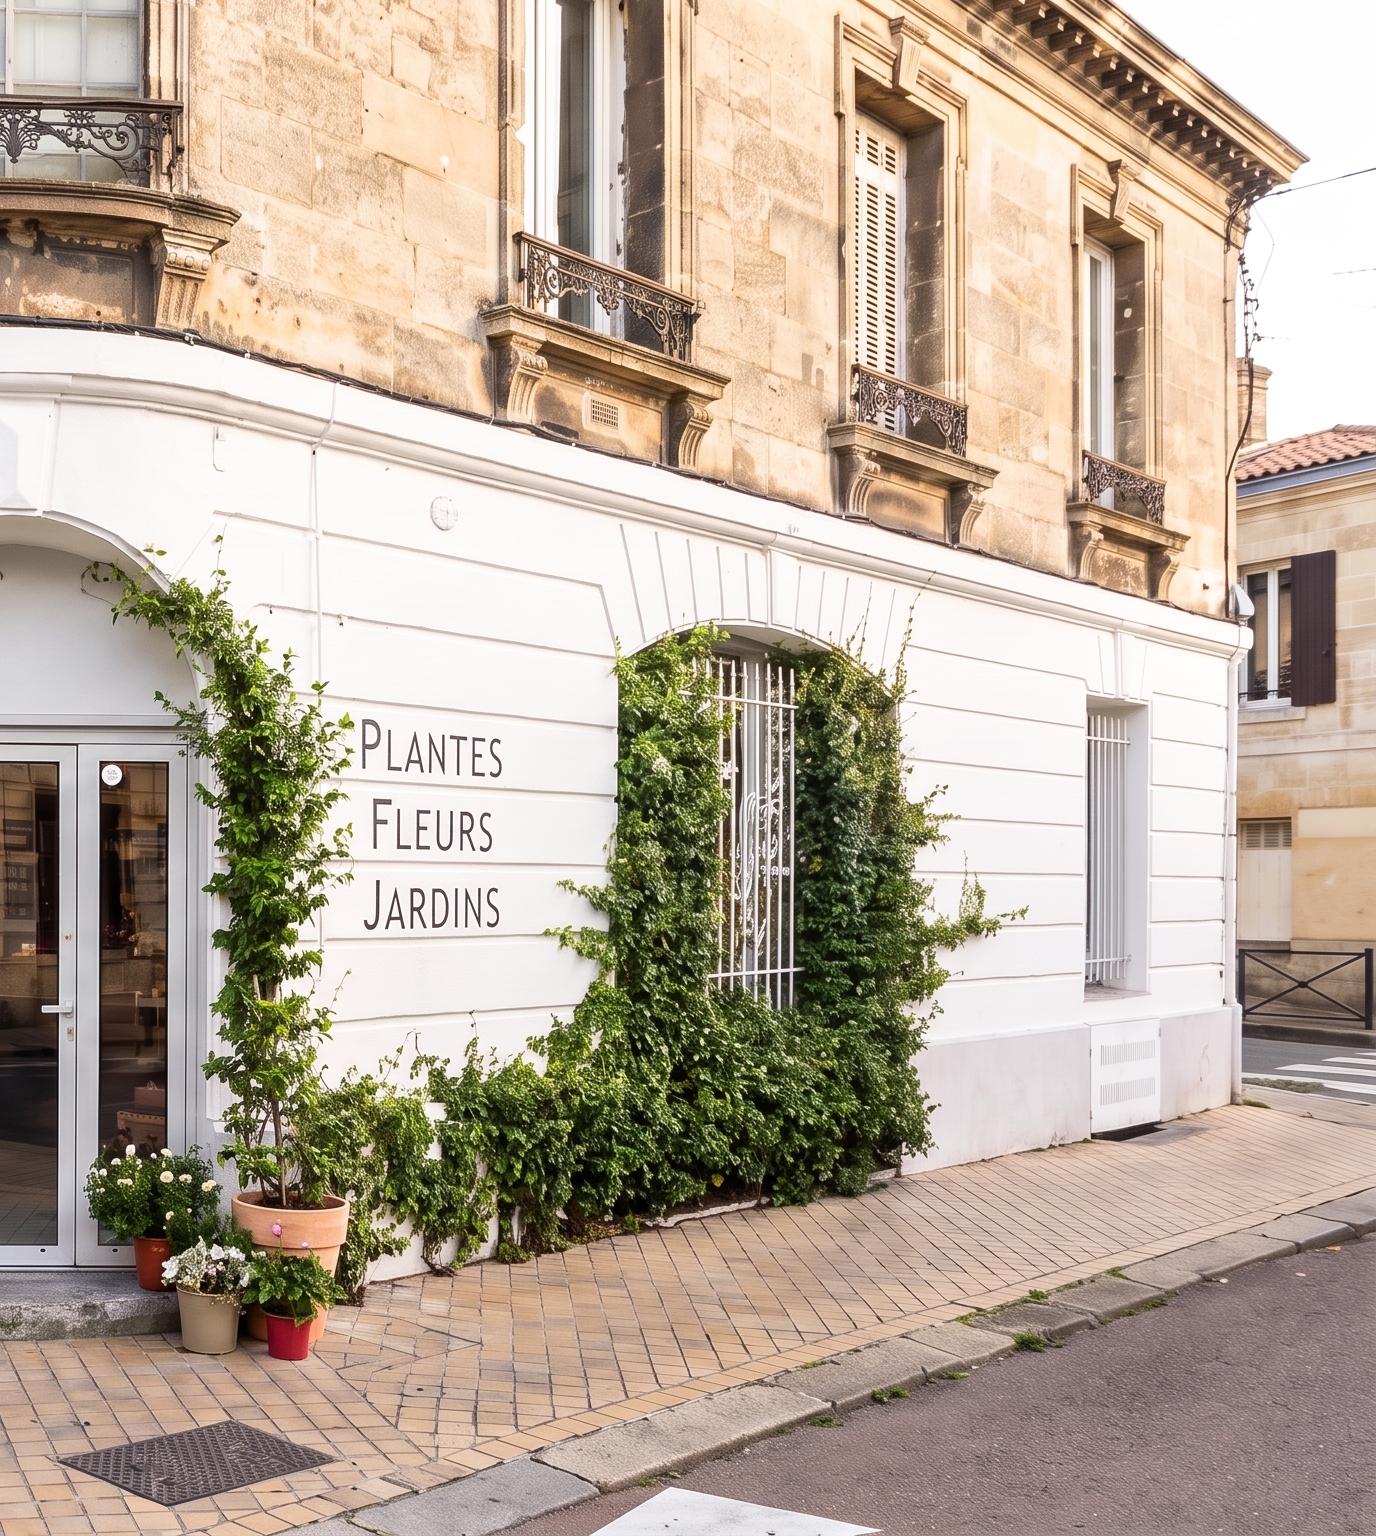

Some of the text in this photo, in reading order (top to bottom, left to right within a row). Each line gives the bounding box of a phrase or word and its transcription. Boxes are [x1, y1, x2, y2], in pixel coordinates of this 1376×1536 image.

[361, 719, 503, 778] PLANTES
[372, 798, 493, 852] FLEURS
[363, 879, 500, 930] JARDINS
